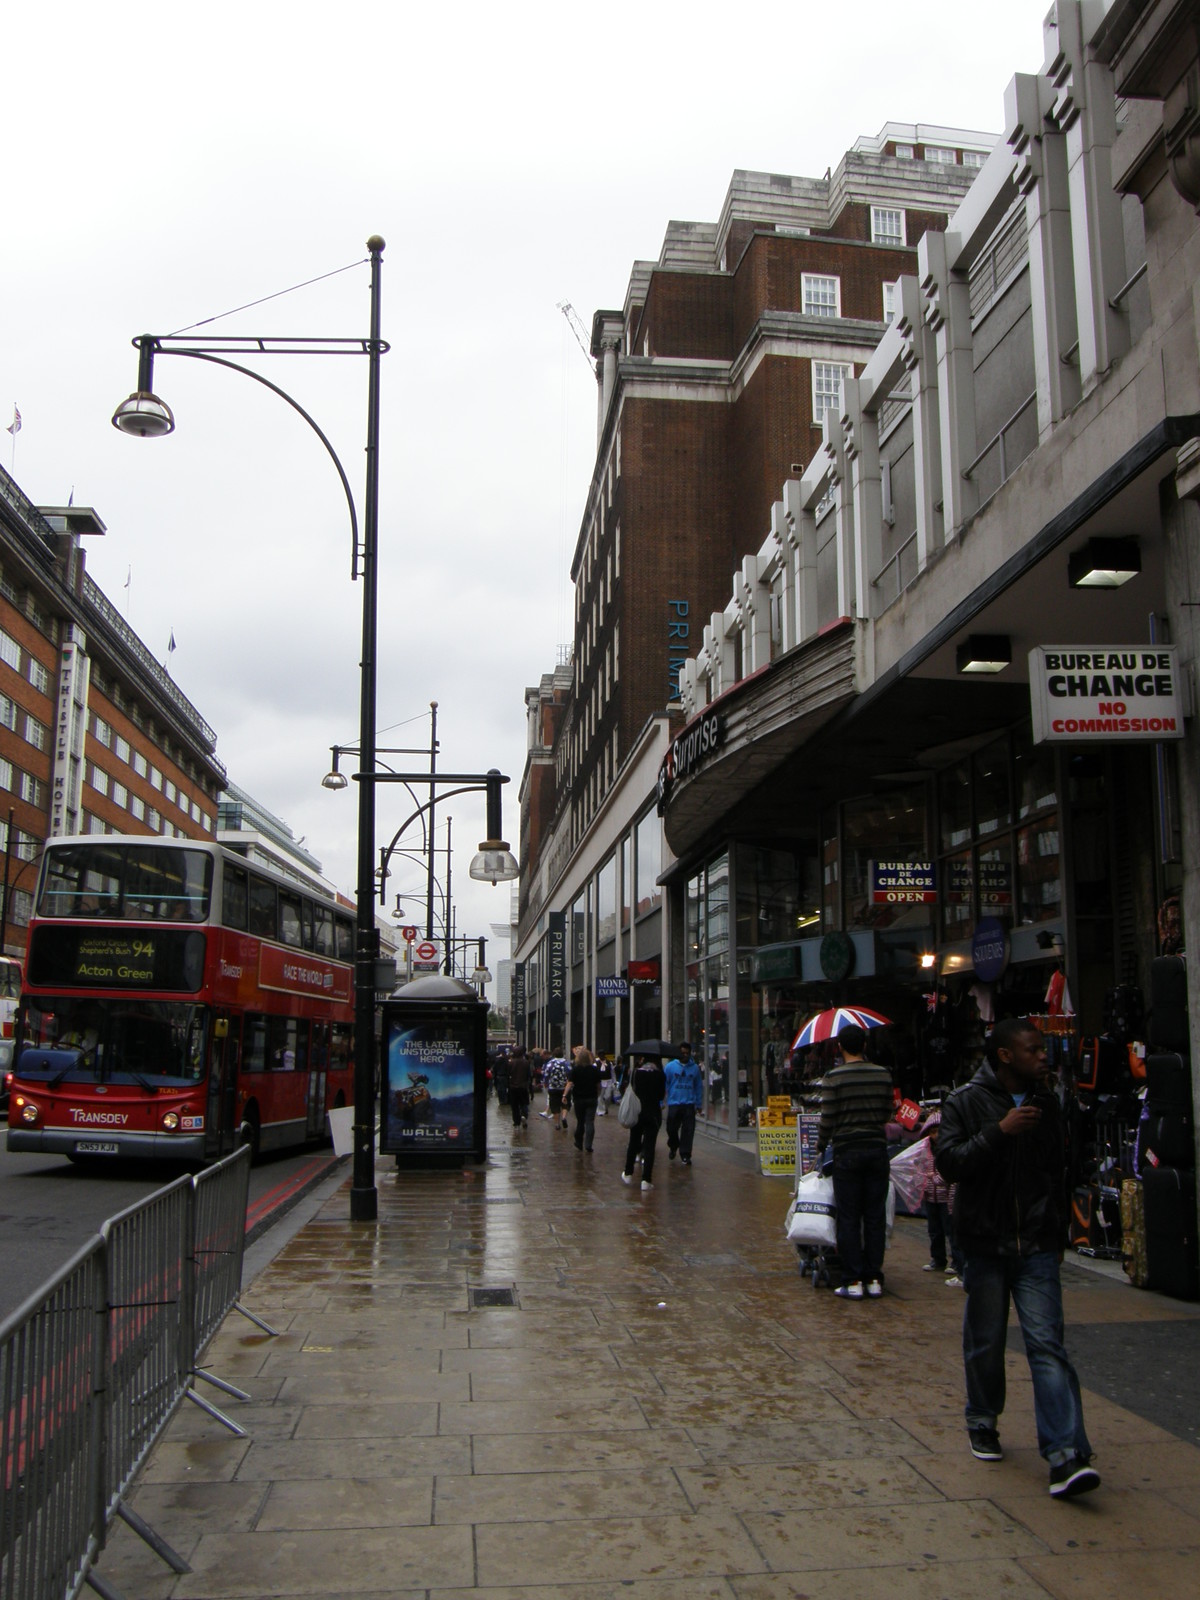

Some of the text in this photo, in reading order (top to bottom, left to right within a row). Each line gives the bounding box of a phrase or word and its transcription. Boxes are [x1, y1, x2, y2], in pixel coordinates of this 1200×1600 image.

[1045, 653, 1170, 670] BUREAU DE
[1048, 675, 1173, 697] CHANGE
[58, 669, 71, 761] THISTLE
[1099, 702, 1126, 716] NO
[1053, 718, 1176, 732] COMMISSION
[672, 715, 719, 778] Surprise
[878, 862, 932, 870] BUREAU
[878, 877, 933, 885] CHANGE
[886, 893, 925, 902] OPEN
[132, 939, 155, 957] 94
[77, 964, 154, 979] Acton Green
[552, 931, 563, 999] PRIMARK
[283, 964, 297, 981] RACE
[298, 967, 306, 982] THE
[306, 969, 324, 986] WORLD
[598, 978, 629, 988] MONEY
[516, 974, 524, 1016] PRIMARK
[400, 1048, 465, 1056] UNSTOPPABLE
[69, 1108, 129, 1125] TRANSDEV
[79, 1143, 116, 1152] SN53 KJA
